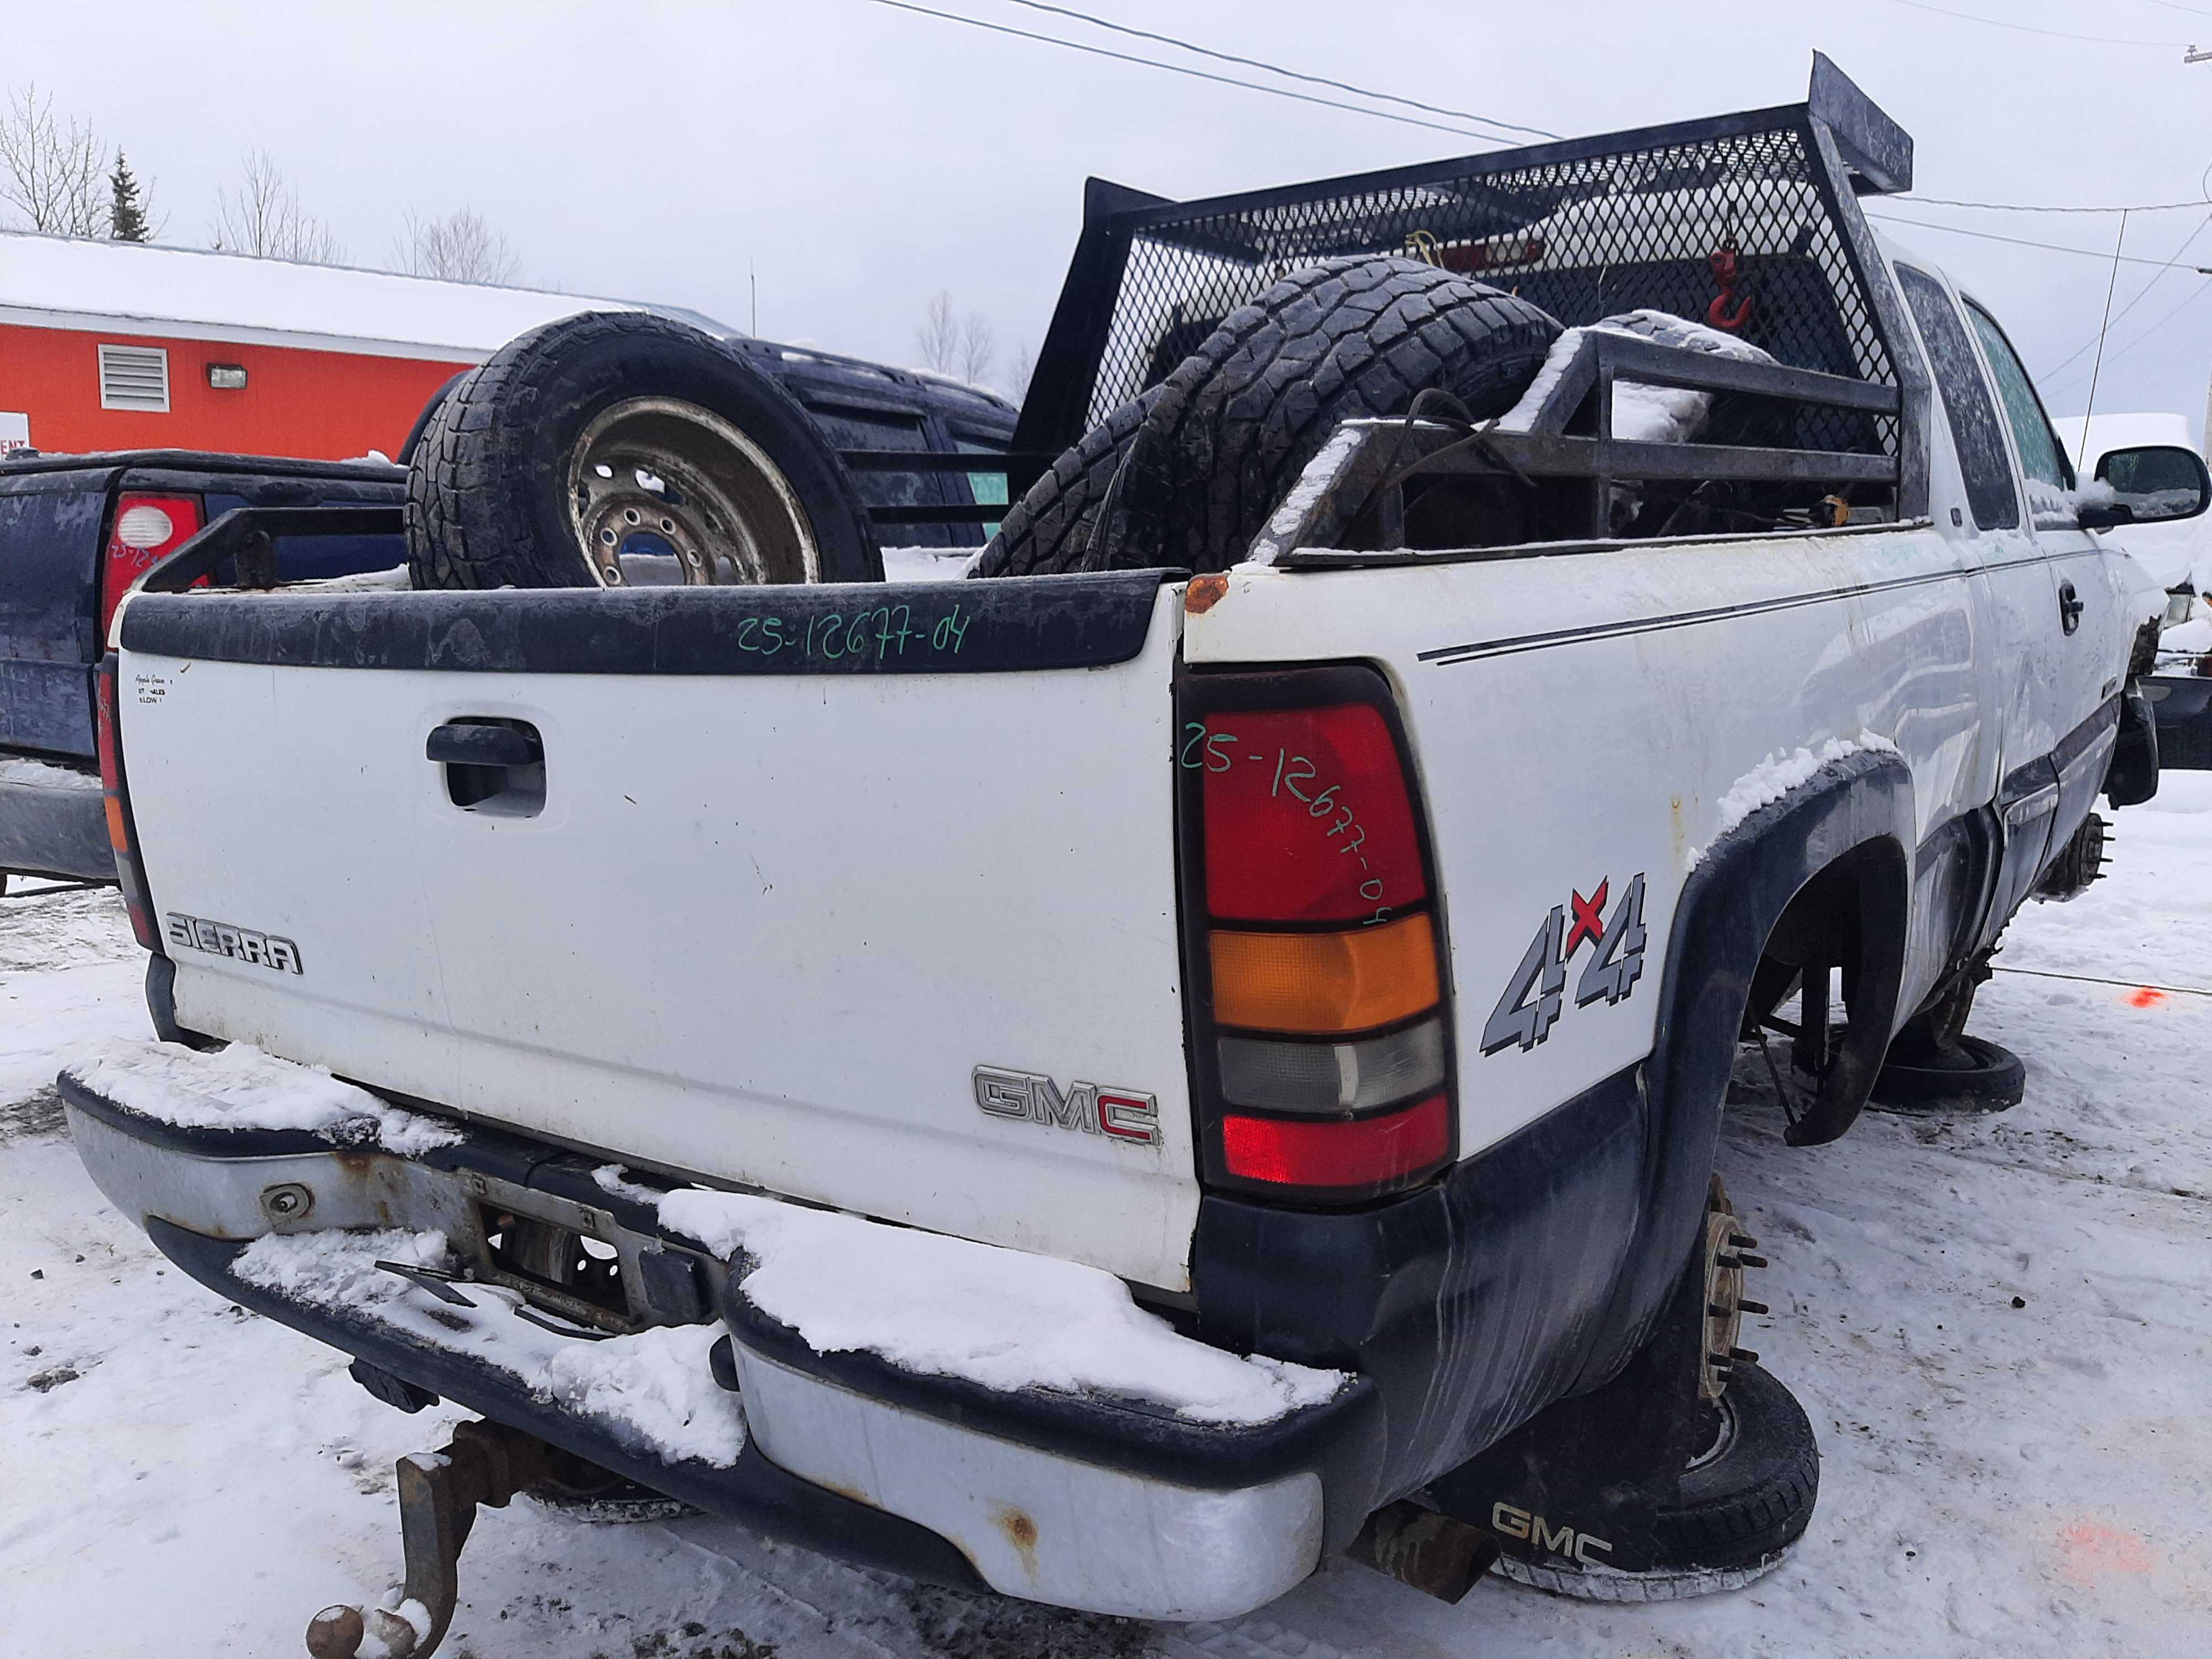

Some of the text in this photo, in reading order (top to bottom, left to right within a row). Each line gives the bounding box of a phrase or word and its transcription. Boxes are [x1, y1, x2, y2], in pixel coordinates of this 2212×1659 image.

[737, 603, 972, 660] 25-12677-04
[1181, 722, 1392, 925] 25-12677-04
[166, 911, 304, 975] SIERRA
[971, 1064, 1163, 1147] GMC
[1492, 1501, 1613, 1566] GMC
